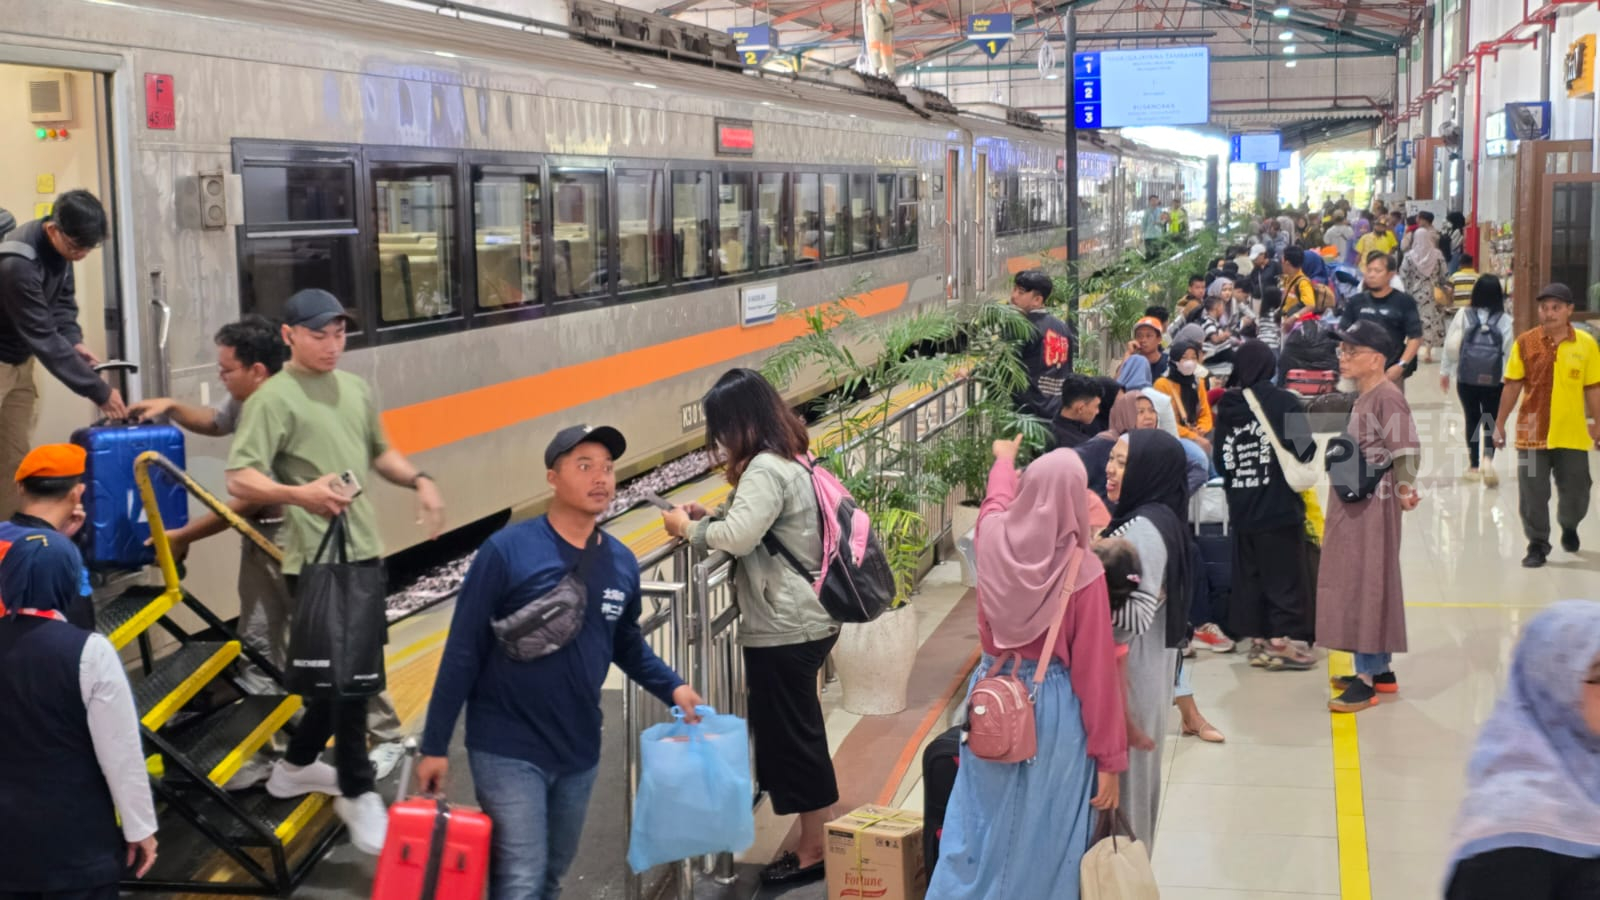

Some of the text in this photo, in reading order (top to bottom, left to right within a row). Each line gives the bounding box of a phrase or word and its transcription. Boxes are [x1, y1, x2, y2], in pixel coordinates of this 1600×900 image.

[986, 41, 996, 54] 1
[745, 51, 758, 65] 2
[1085, 63, 1093, 73] 1
[156, 79, 164, 102] F
[1084, 87, 1093, 99] 2
[1084, 112, 1094, 123] 3
[844, 872, 884, 887] Fortune
